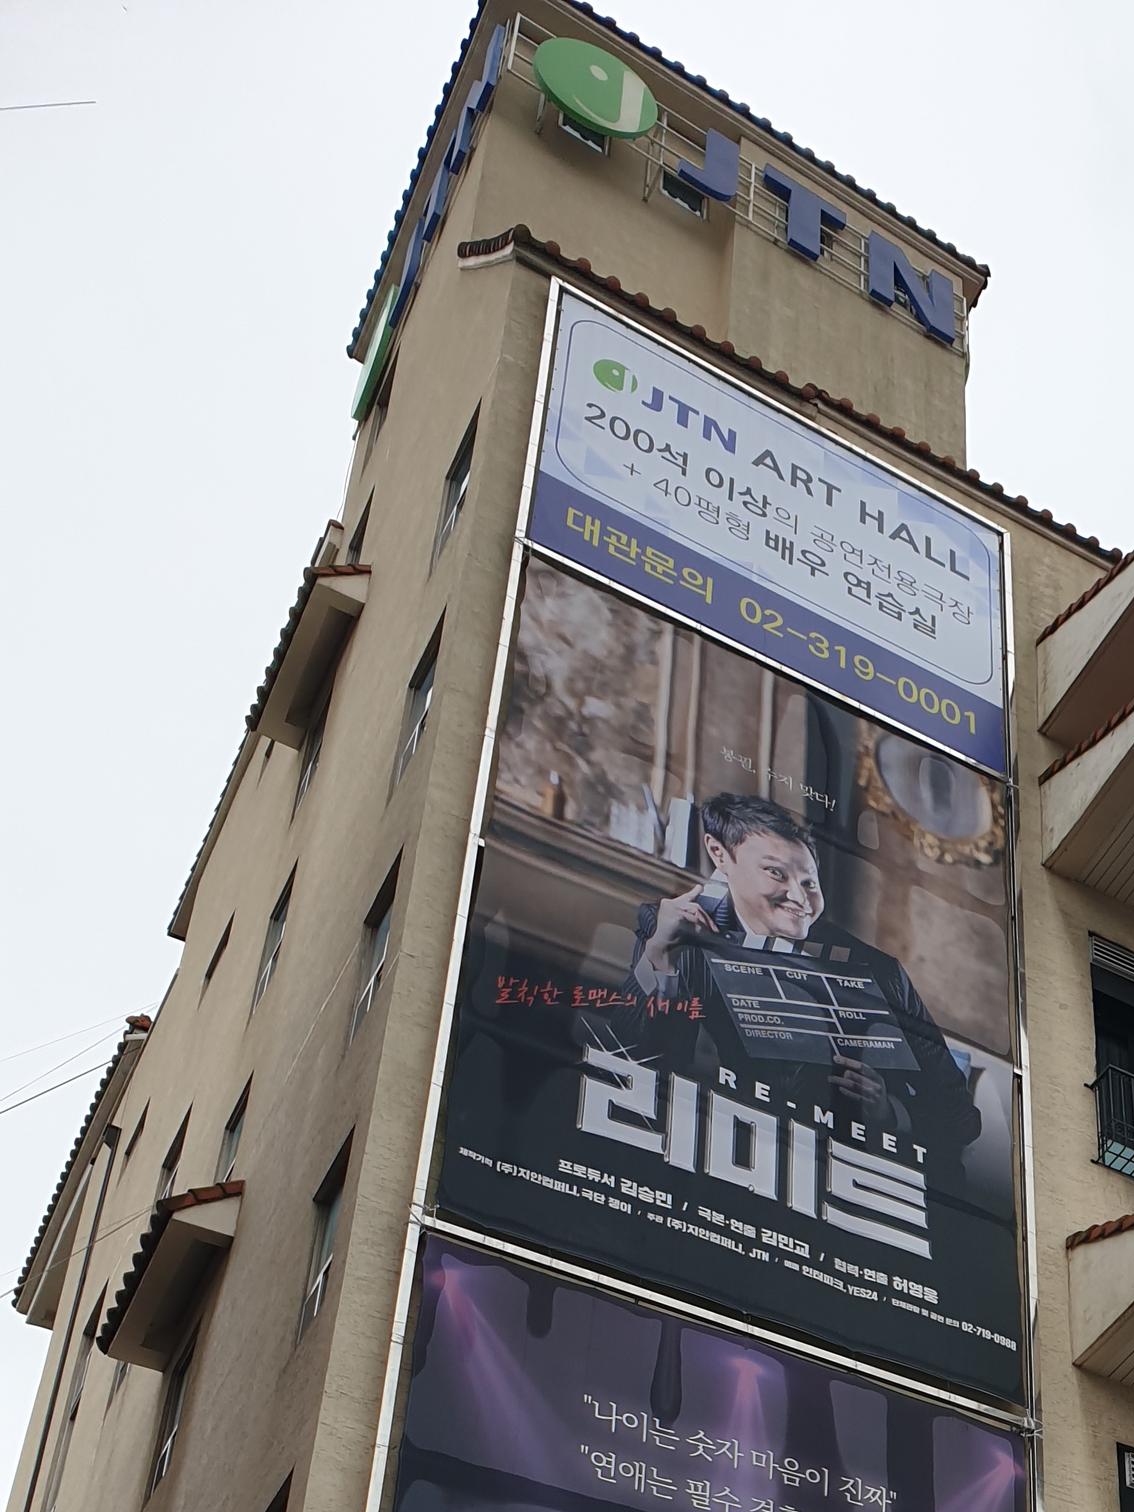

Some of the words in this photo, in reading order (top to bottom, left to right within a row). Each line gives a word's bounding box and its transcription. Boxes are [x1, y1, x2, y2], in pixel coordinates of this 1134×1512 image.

[678, 128, 955, 346] JTN
[584, 402, 689, 477] 200석
[705, 465, 801, 535] 이상의
[811, 525, 974, 625] 공연전용극장
[641, 385, 737, 455] JTN
[752, 449, 841, 508] ART
[859, 501, 971, 581] HALL
[653, 477, 752, 542] 40평형
[764, 528, 830, 579] 배우
[843, 568, 939, 640] 연습실
[567, 505, 715, 604] 대관문의
[739, 596, 977, 735] 02-319-0001
[496, 976, 563, 1007] 발칙한
[676, 997, 706, 1020] 이름
[724, 963, 764, 976] SCENE
[786, 970, 808, 982] CUT
[836, 979, 865, 990] TAKE
[732, 999, 760, 1009] DATE
[839, 1011, 866, 1021] ROLL
[738, 1013, 784, 1025] PROD.CO.
[745, 1029, 793, 1041] DIRECTOR
[837, 1038, 895, 1049] CAMERAMAN
[576, 1043, 934, 1260] 리미트
[557, 1159, 615, 1188] 프로듀서
[620, 1177, 673, 1209] 김승민
[697, 1205, 757, 1239] 극본·연출
[761, 1227, 810, 1259] 김민교
[892, 1275, 939, 1305] 허영웅
[581, 1187, 605, 1206] 극단
[749, 1247, 770, 1262] JTN
[848, 1285, 879, 1302] YES24
[580, 1444, 678, 1500] "연애는
[583, 1393, 681, 1451] "나이는
[686, 1429, 744, 1469] 숫자
[751, 1449, 831, 1497] 마음이
